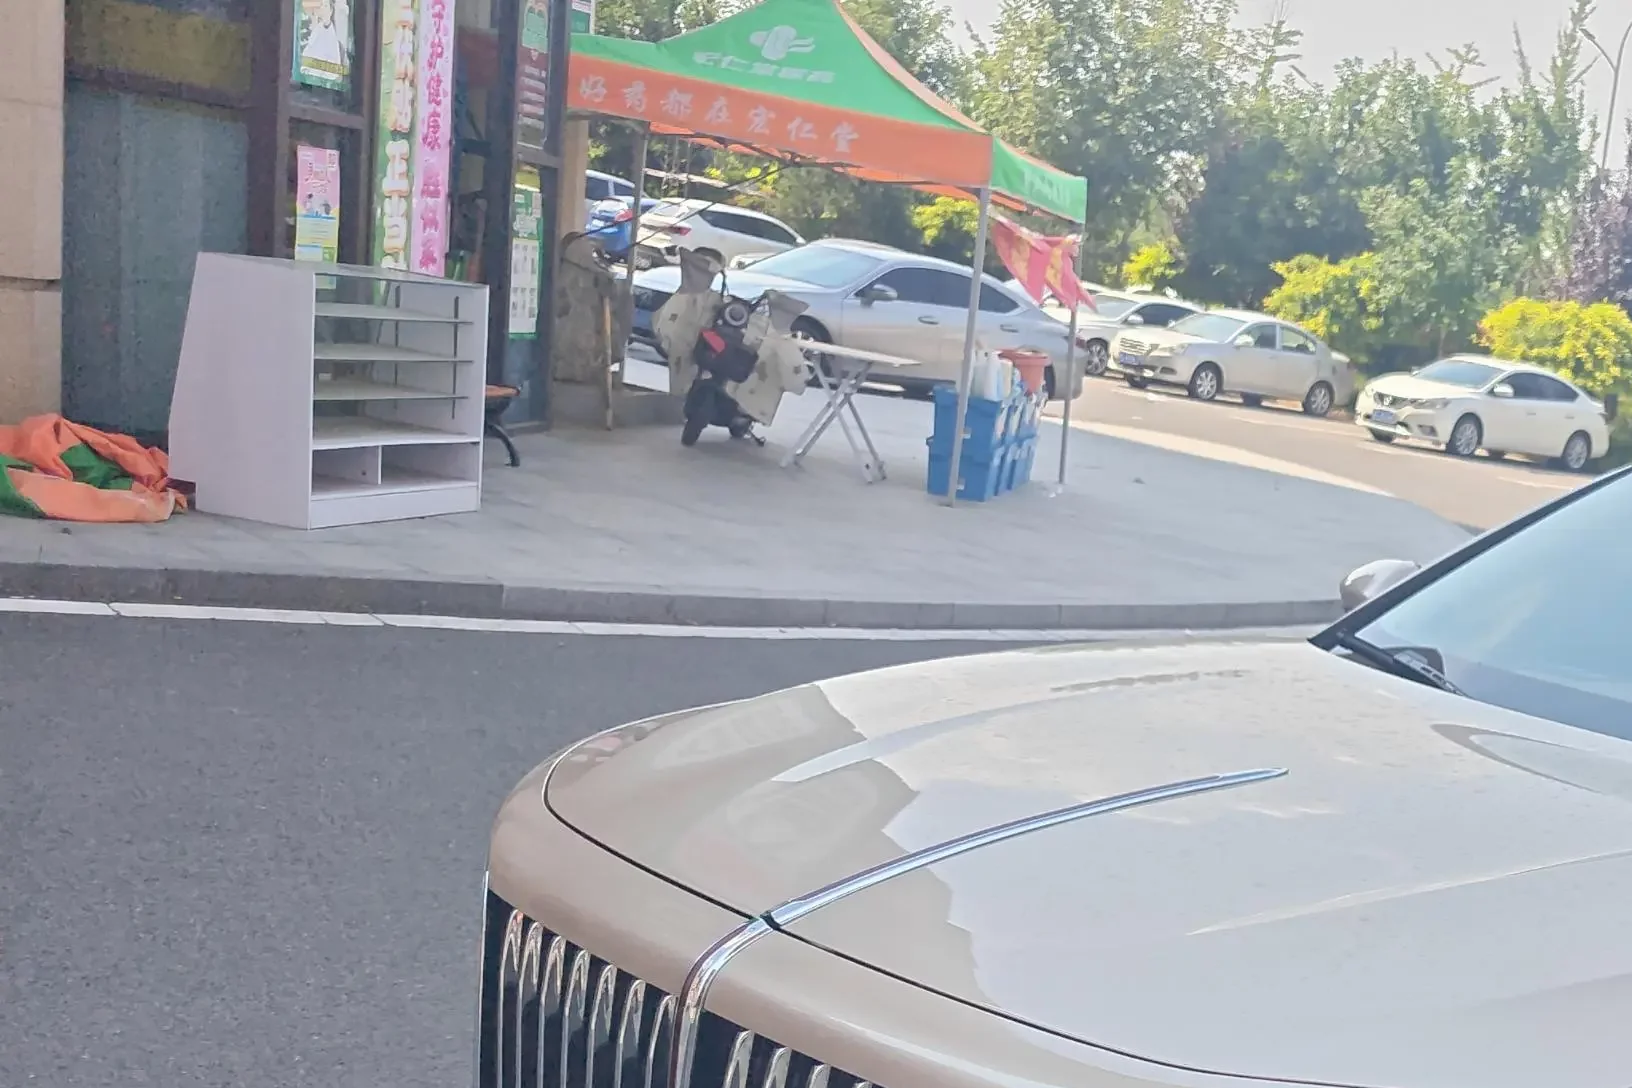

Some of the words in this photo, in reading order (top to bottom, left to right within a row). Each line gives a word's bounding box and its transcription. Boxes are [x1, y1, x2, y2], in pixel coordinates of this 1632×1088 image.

[579, 74, 859, 152] 好药都在宏仁堂
